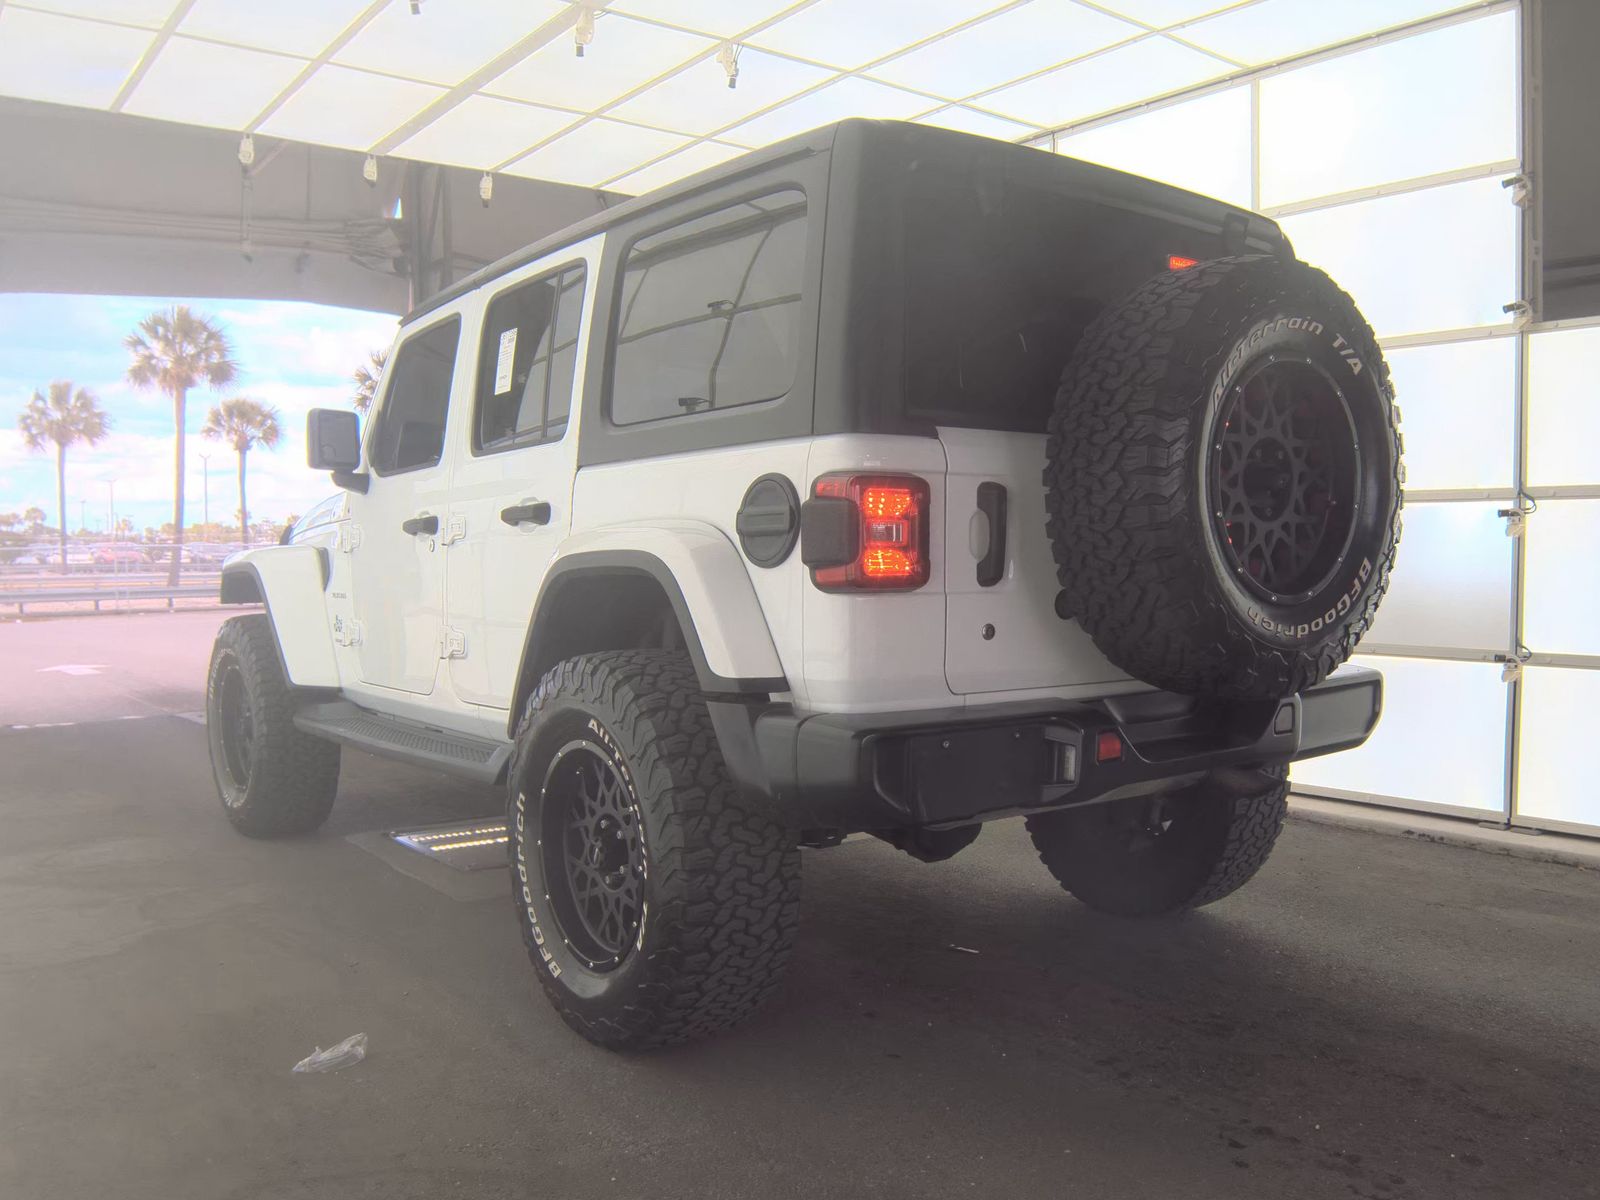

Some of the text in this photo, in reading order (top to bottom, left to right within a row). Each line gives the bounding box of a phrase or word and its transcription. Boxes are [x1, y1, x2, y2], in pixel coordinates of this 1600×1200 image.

[1332, 333, 1363, 376] T/A
[1248, 557, 1372, 638] BFGoodrich
[515, 791, 562, 978] BFGoodrich
